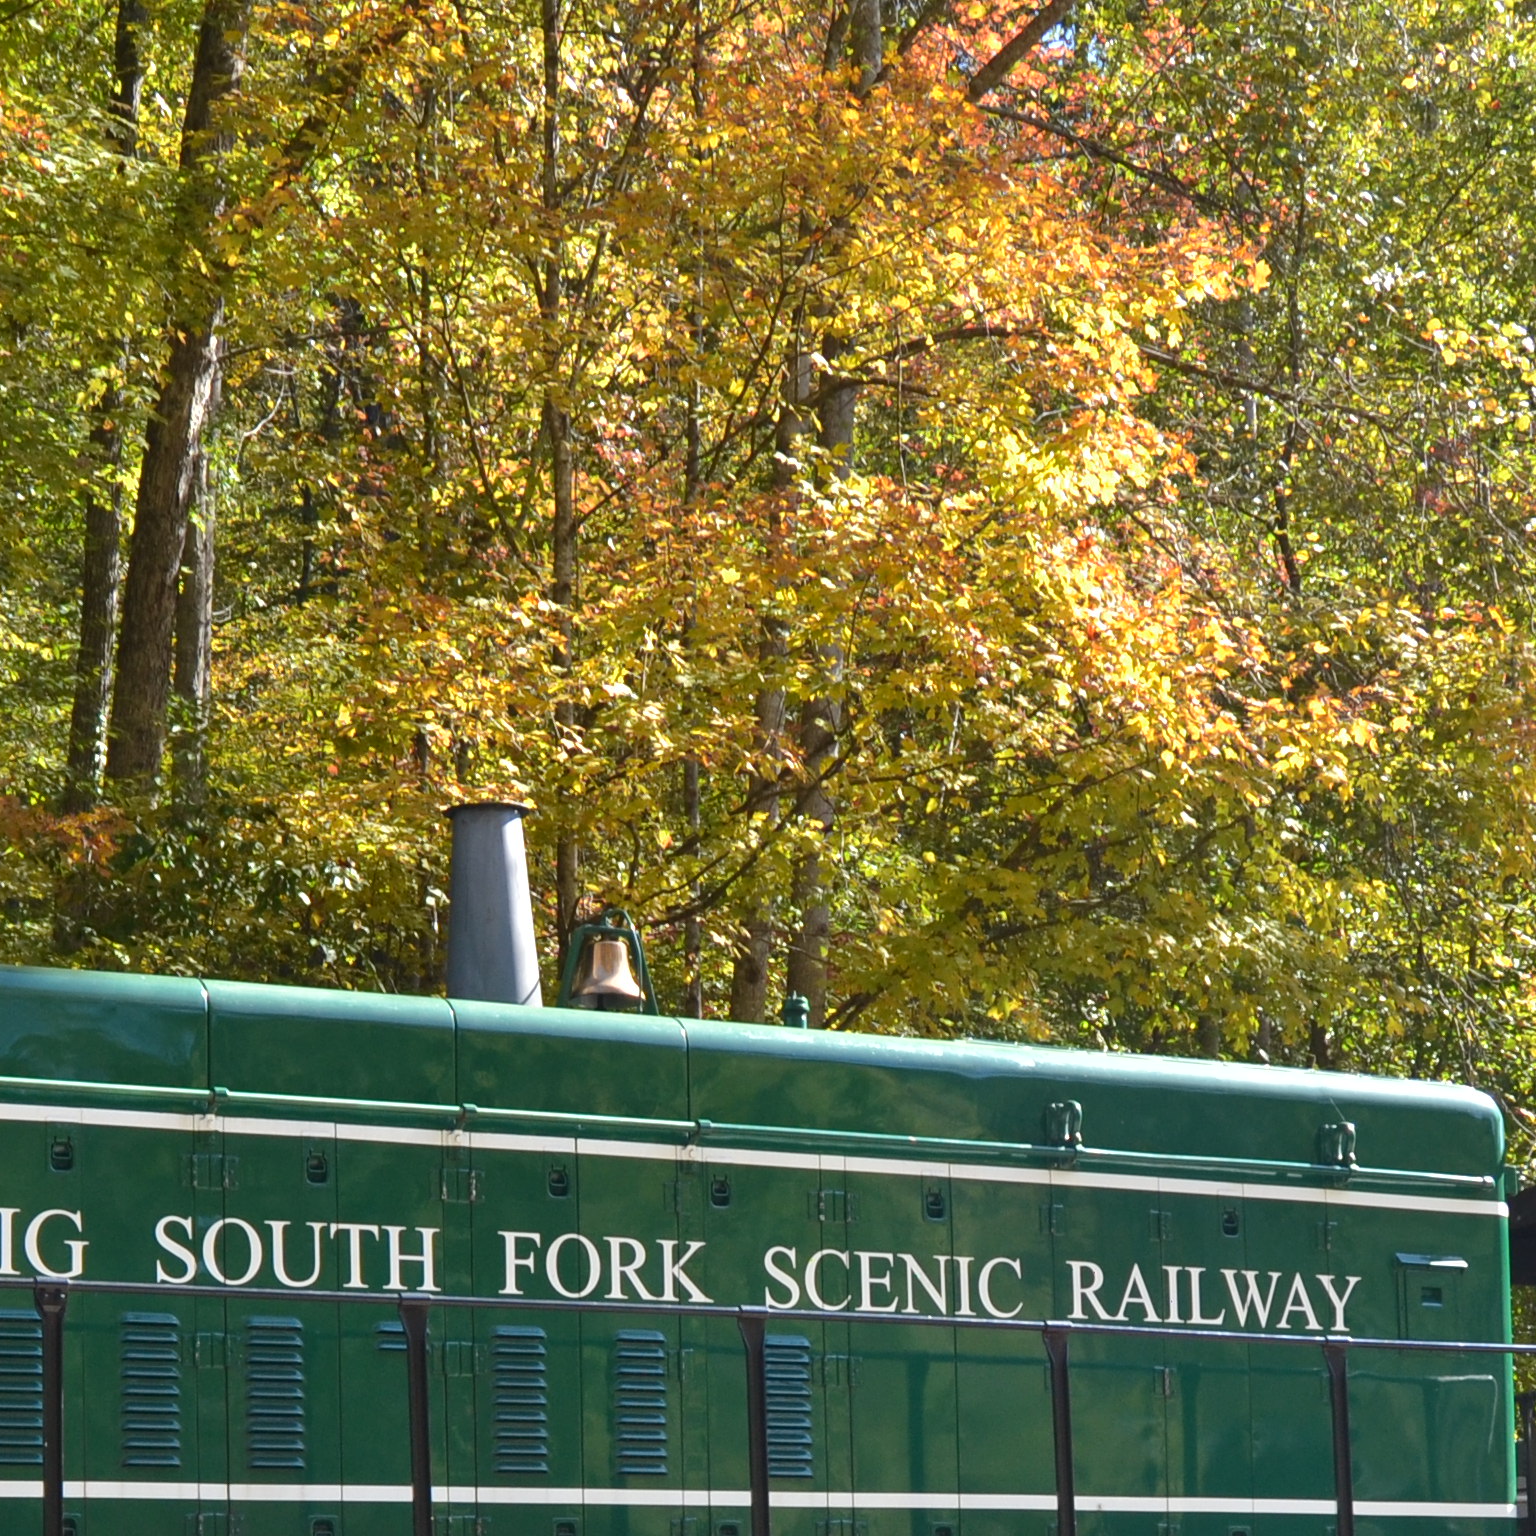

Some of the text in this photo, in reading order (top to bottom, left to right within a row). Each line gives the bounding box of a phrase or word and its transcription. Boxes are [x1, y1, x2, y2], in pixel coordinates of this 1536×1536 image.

[155, 1215, 442, 1292] SOUTH
[497, 1230, 714, 1303] FORK
[764, 1246, 1024, 1318] SCENIC
[1066, 1260, 1362, 1331] RAILWAY
